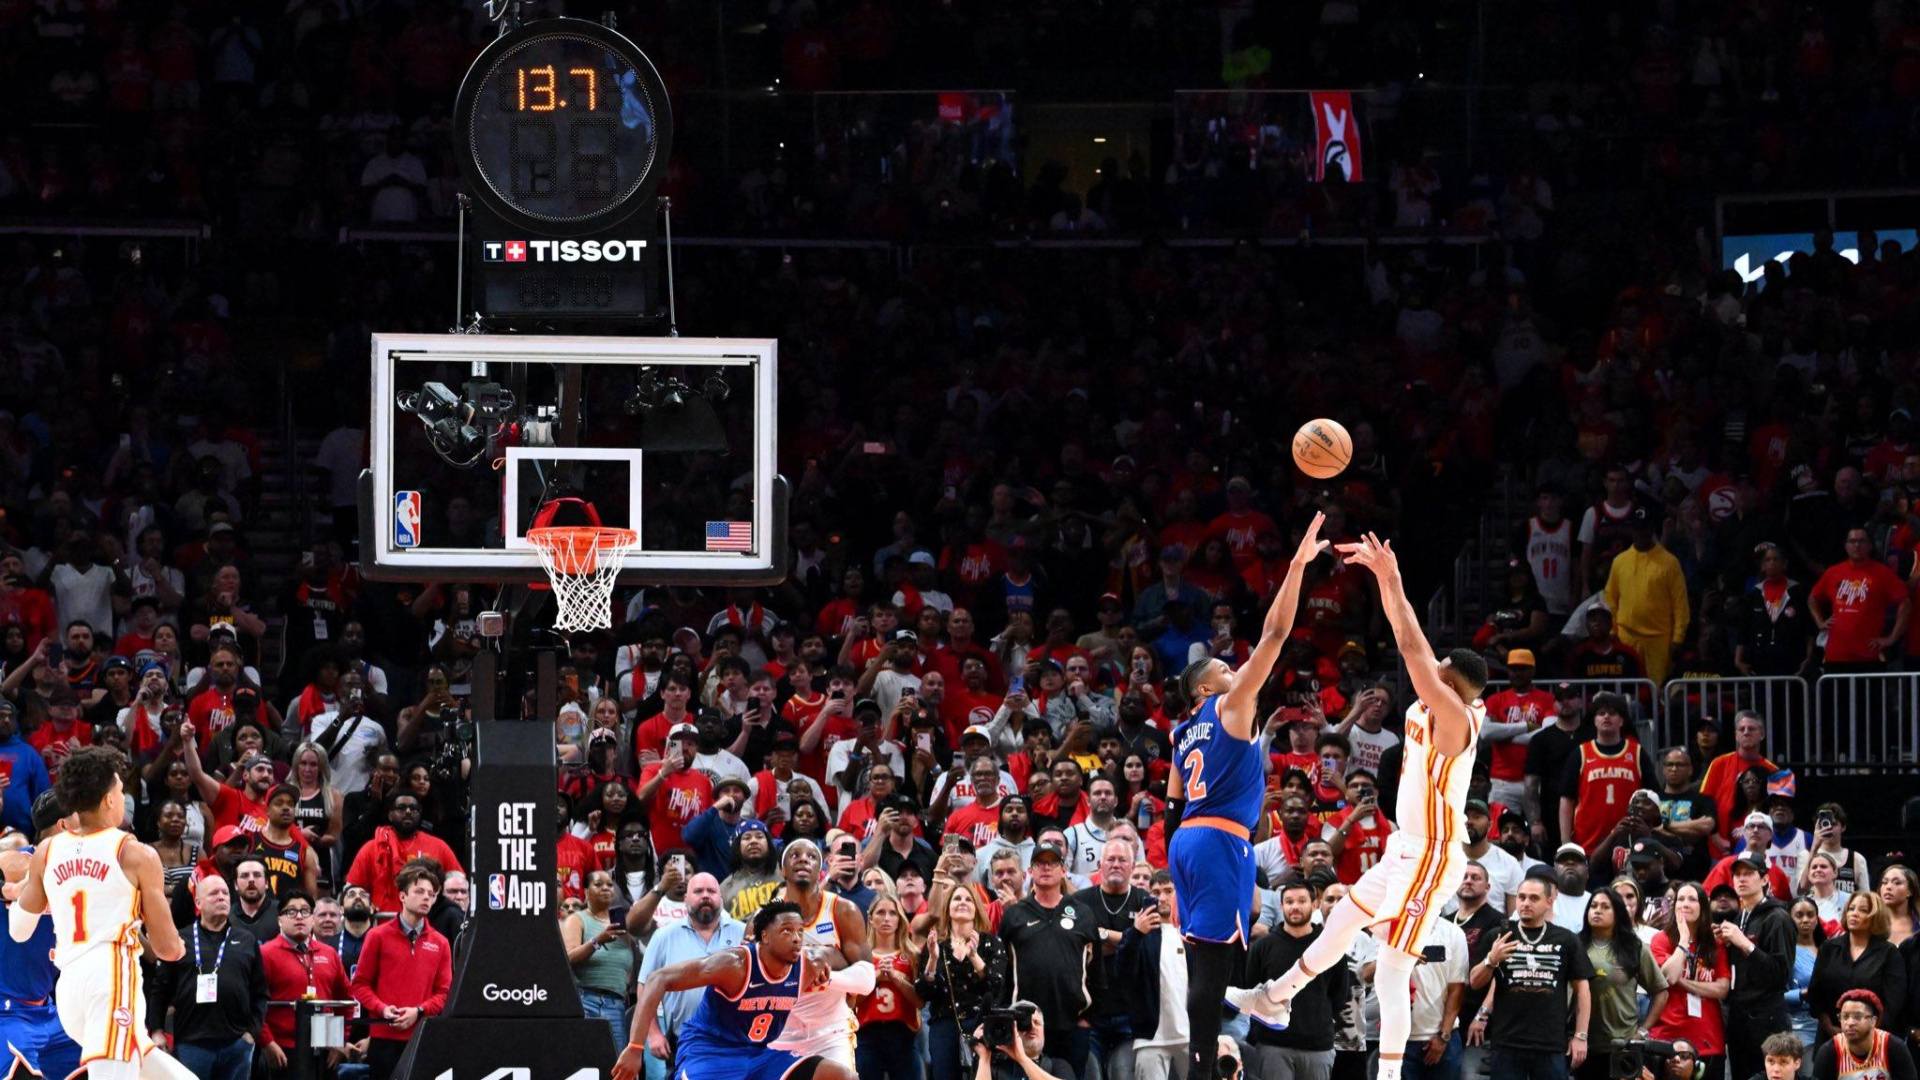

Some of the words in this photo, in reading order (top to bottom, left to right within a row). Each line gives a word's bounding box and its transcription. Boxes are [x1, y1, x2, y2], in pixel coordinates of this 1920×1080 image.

[517, 64, 597, 112] 13.7
[530, 240, 647, 262] TISSOT
[398, 533, 411, 544] NBA
[1542, 558, 1558, 579] 11
[1587, 663, 1623, 676] HAWKS
[1178, 722, 1214, 756] McBRIDE
[1352, 757, 1380, 770] PEDR
[1360, 751, 1380, 761] FOR
[1184, 748, 1207, 801] 2
[1587, 766, 1634, 782] ATLANTA
[956, 784, 1008, 799] HAS
[1606, 783, 1615, 805] 1
[497, 802, 537, 836] GET
[497, 839, 537, 872] THE
[1085, 847, 1096, 862] 5
[54, 858, 110, 886] JOHNSON
[264, 857, 298, 878] AWKS
[507, 875, 547, 917] App
[71, 889, 89, 944] 1
[482, 982, 549, 1006] Google
[738, 997, 769, 1011] NEW
[876, 987, 895, 1014] 3
[748, 1013, 774, 1043] 8
